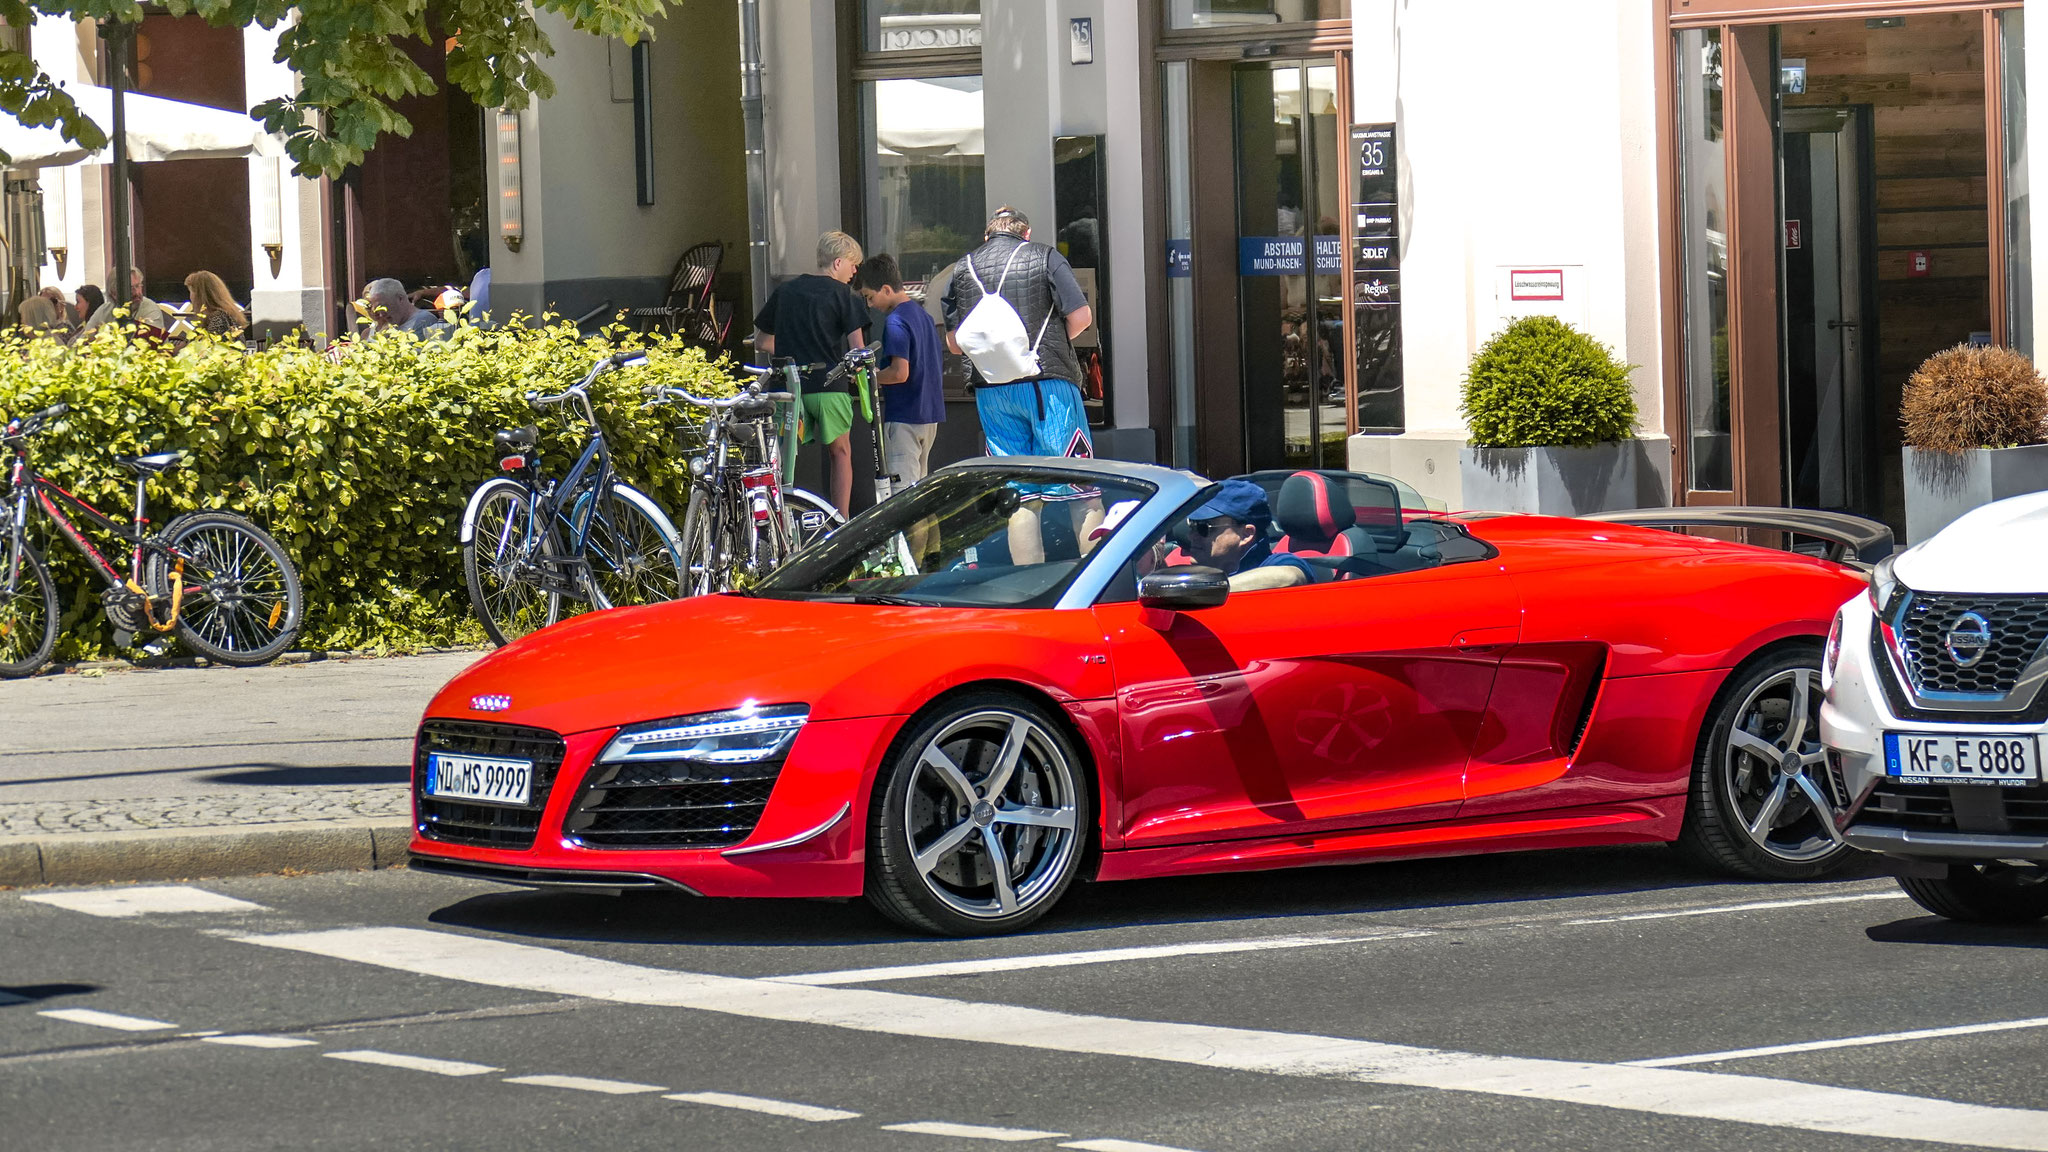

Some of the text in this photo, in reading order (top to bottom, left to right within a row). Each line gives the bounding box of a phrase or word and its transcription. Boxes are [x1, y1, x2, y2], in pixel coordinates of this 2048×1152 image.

[1072, 21, 1089, 43] 35
[1361, 141, 1384, 166] 35
[1264, 242, 1303, 256] ABSTAND
[1362, 247, 1389, 259] SIDLEY
[1253, 258, 1302, 270] MUND-NASEN-
[1364, 283, 1389, 296] Regus
[784, 411, 793, 431] Bolt
[1079, 655, 1106, 664] V10
[1908, 739, 1938, 772] KF
[1955, 740, 1973, 773] E
[1978, 740, 2025, 774] 888
[435, 760, 526, 798] ND MS 9999
[1899, 776, 1929, 784] NISSAN
